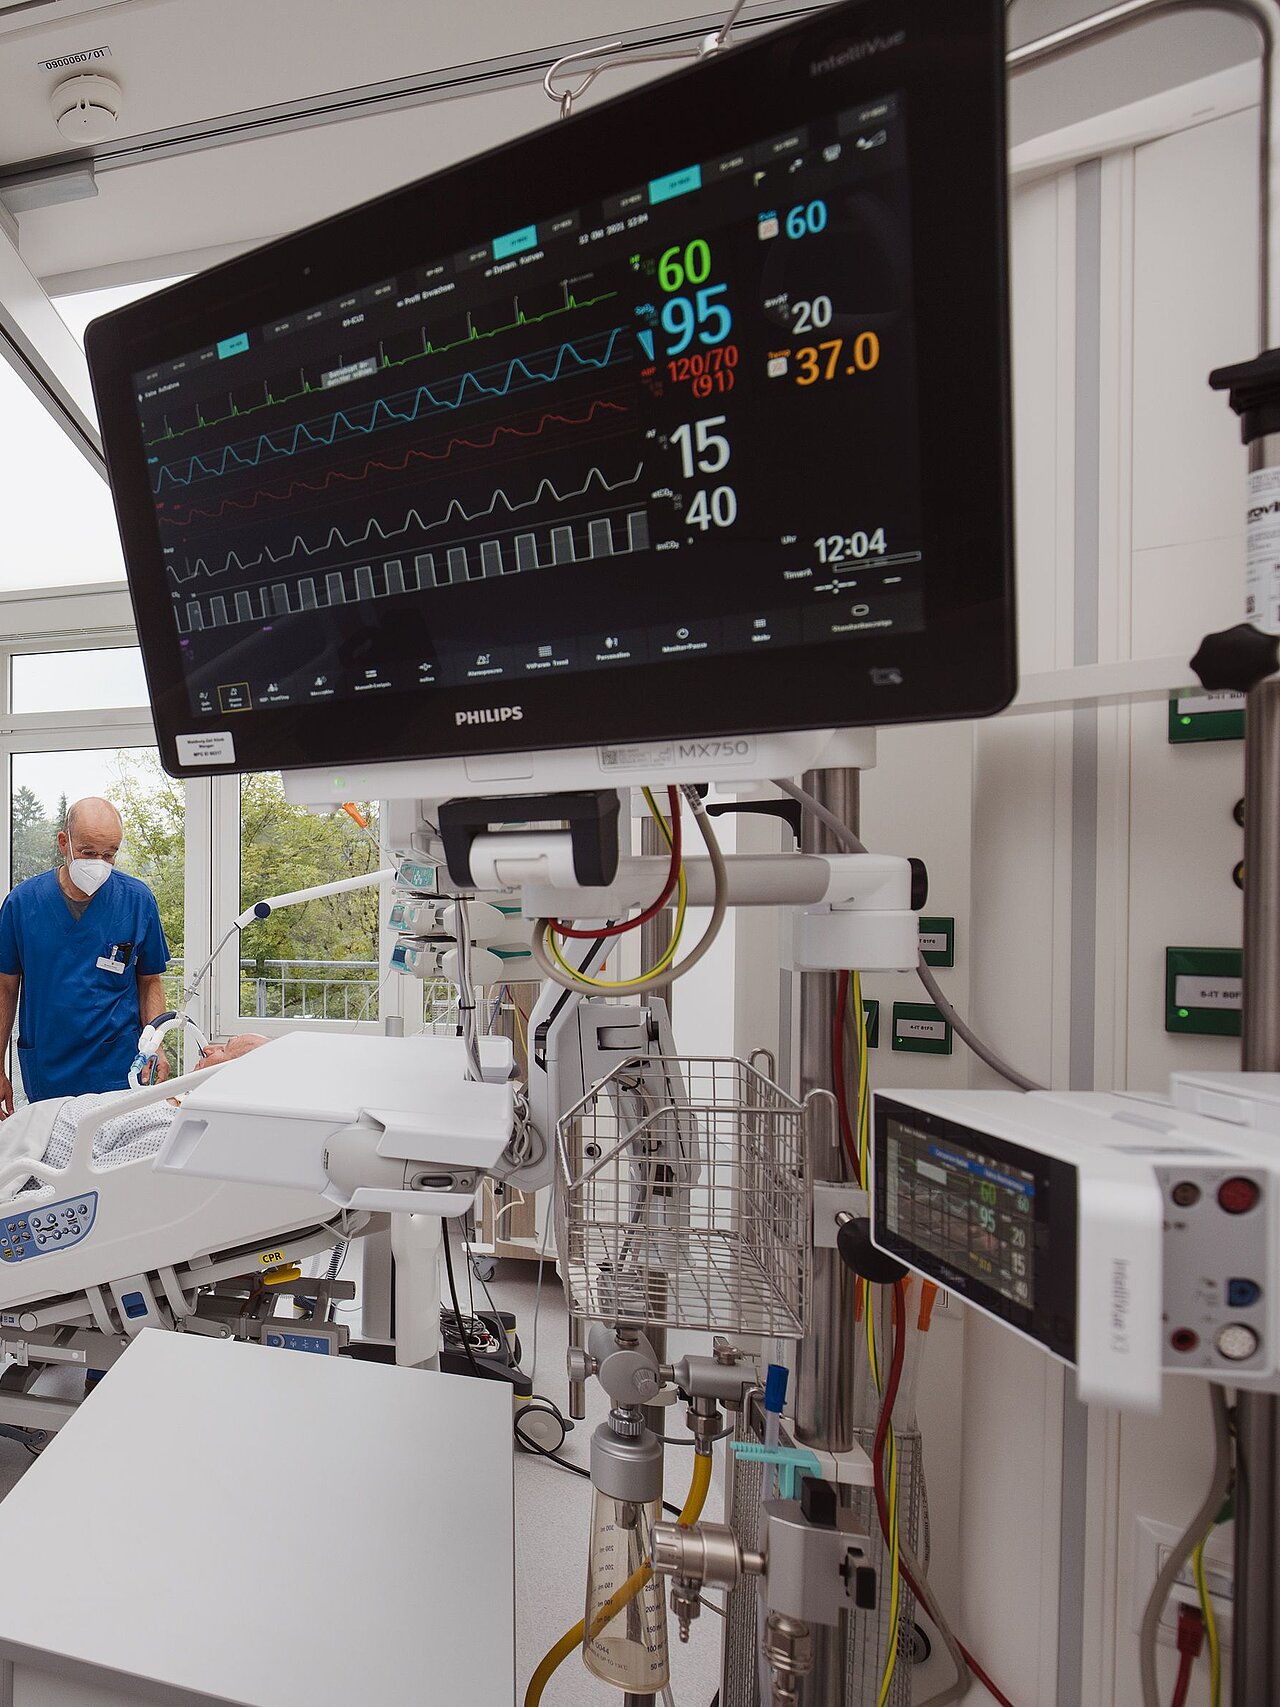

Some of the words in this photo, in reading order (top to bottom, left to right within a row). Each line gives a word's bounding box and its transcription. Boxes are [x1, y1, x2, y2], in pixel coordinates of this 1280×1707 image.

[810, 30, 906, 77] IntelliVue
[785, 199, 828, 240] 60
[658, 238, 712, 293] 60
[661, 282, 732, 357] 95
[791, 295, 833, 335] 20
[667, 344, 739, 384] 120/70
[795, 331, 880, 386] 37.0
[692, 369, 735, 399] (91)
[669, 415, 731, 479] 15
[685, 485, 738, 531] 40
[813, 527, 888, 564] 12:04
[455, 705, 524, 726] PHILIPS
[679, 740, 749, 759] MX750
[979, 1205, 996, 1233] 95
[1010, 1225, 1026, 1249] 20
[262, 1252, 283, 1263] CPR
[1011, 1251, 1026, 1277] 15
[647, 1645, 657, 1653] 100
[650, 1662, 658, 1671] 50
